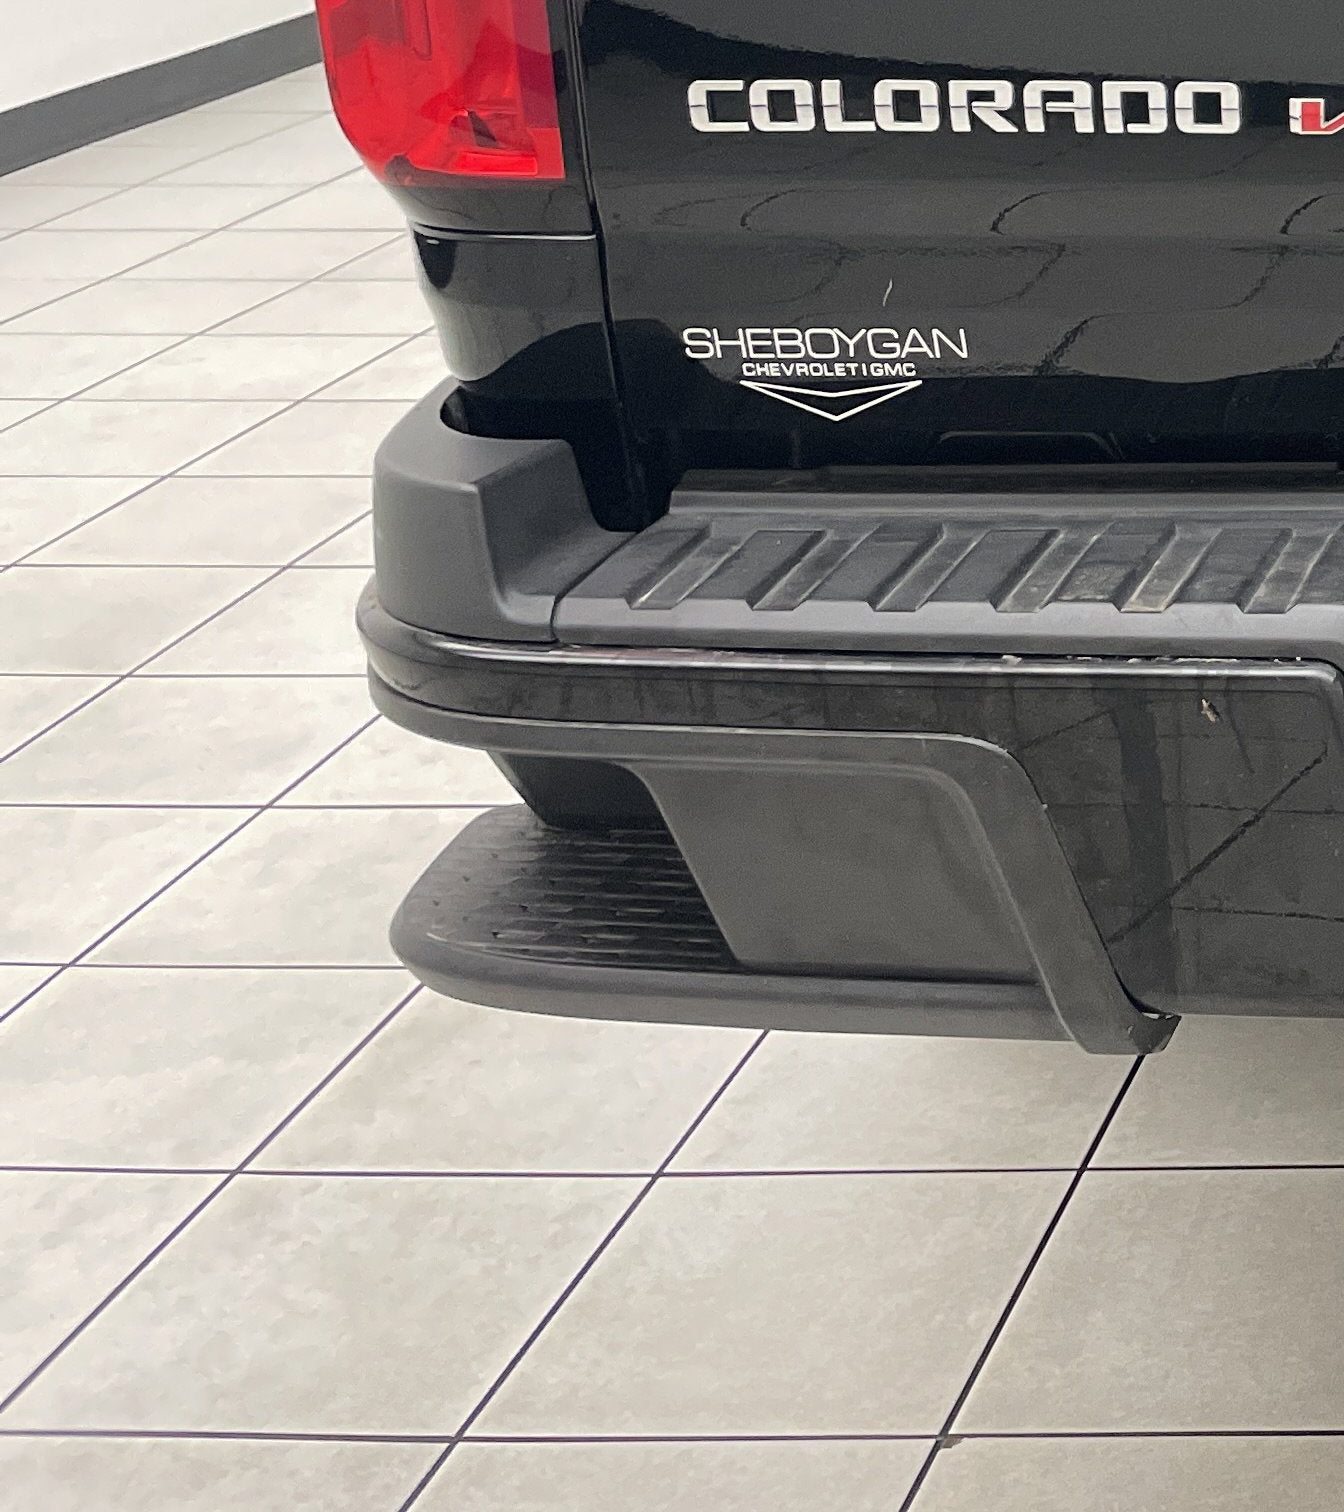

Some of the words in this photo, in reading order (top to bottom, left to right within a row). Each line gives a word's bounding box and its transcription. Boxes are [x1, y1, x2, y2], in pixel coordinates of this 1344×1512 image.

[687, 78, 1242, 135] COLORADO
[682, 327, 970, 360] SHEBOYGAN
[741, 362, 860, 378] CHEVROLET
[869, 362, 918, 378] GMC
